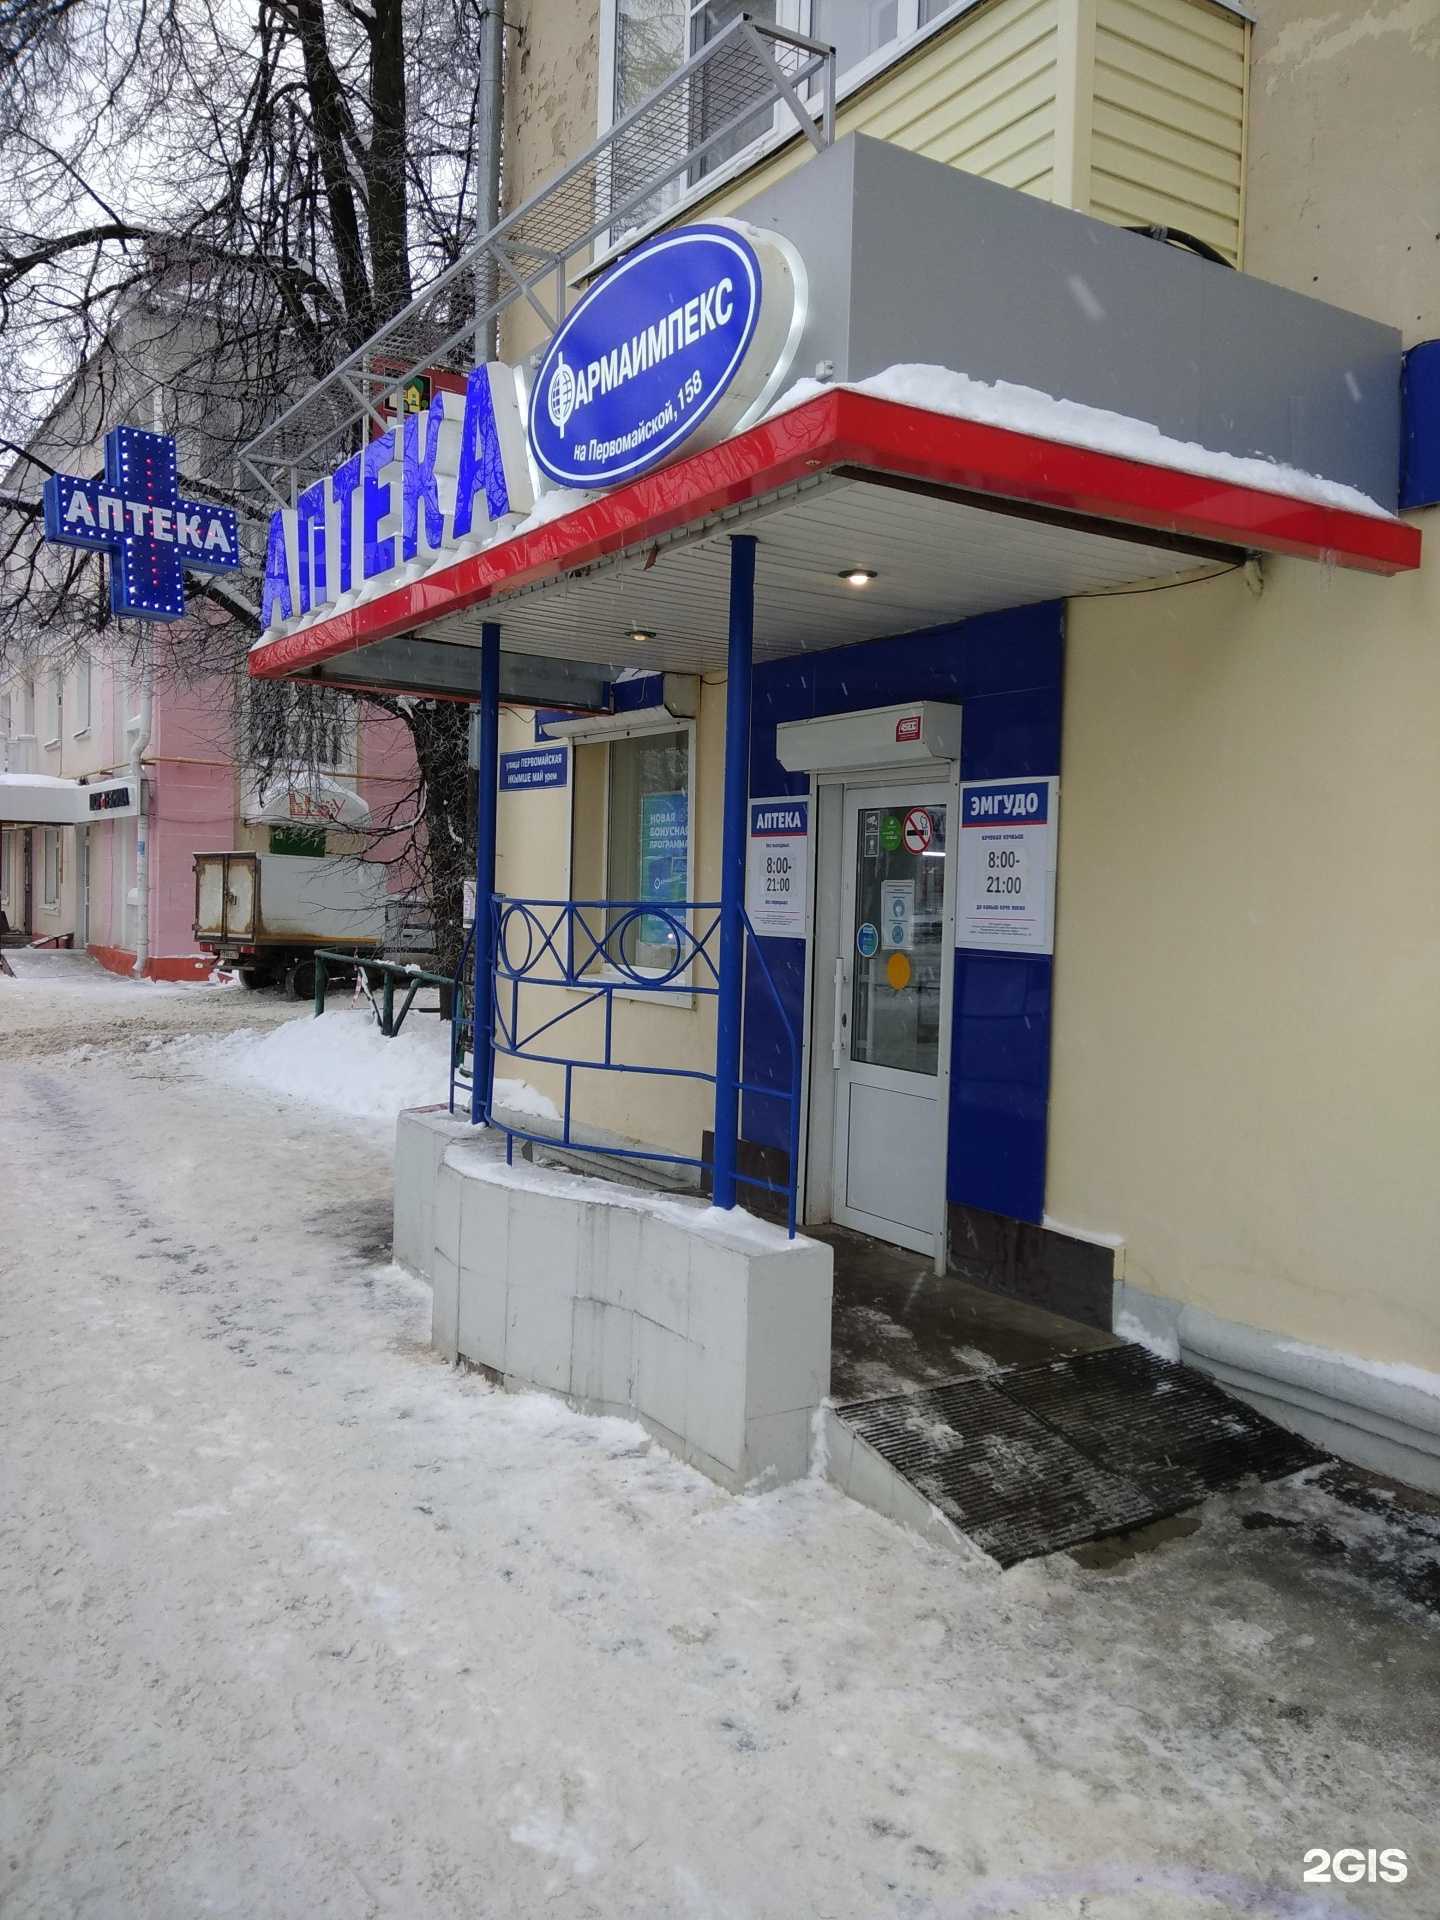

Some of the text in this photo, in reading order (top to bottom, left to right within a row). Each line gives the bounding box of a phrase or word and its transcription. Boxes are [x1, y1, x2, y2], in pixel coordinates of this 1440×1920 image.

[574, 369, 703, 464] на Первомайской, 158
[261, 363, 511, 631] АПТЕКА
[65, 490, 232, 553] АПТЕКА
[521, 753, 562, 768] ПЕРВОМАЙСКАЯ
[532, 770, 544, 782] МАЙ
[970, 792, 1039, 816] ЭМГУДО
[650, 813, 676, 823] НОВАЯ
[756, 811, 801, 829] АПТЕКА
[766, 856, 792, 874] 8:00-
[987, 850, 1021, 869] 8:00-
[766, 877, 790, 892] 21:00
[986, 876, 1022, 894] 21:00
